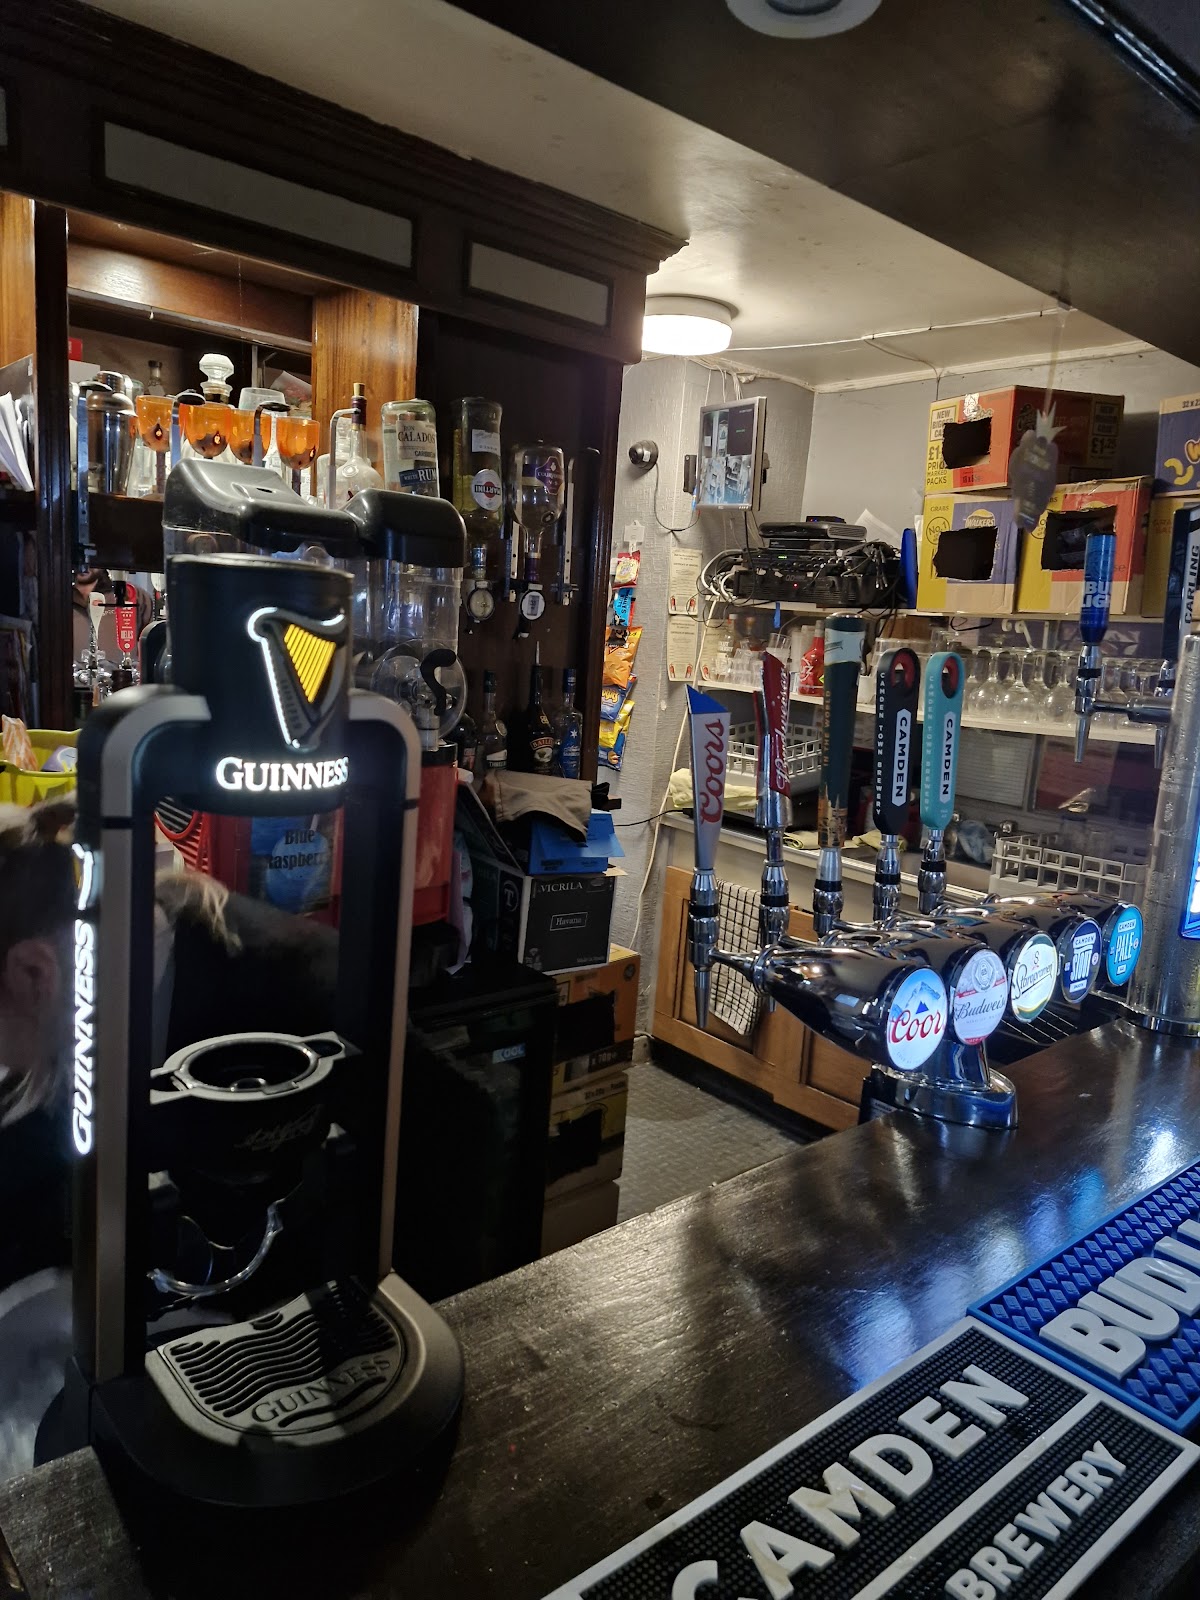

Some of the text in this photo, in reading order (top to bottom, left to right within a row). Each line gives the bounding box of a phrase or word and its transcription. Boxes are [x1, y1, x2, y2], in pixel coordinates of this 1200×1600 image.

[936, 410, 951, 419] NEW
[397, 431, 436, 444] CALADOS
[418, 467, 437, 482] RUM
[926, 476, 948, 486] PACKS
[965, 517, 995, 527] WALKERS
[1184, 545, 1200, 625] CARLING
[926, 675, 935, 720] CAMDEN
[895, 716, 908, 797] CAMDEN
[942, 718, 953, 795] CAMDEN
[215, 756, 349, 792] GUINNESS
[700, 718, 724, 826] Coors
[285, 829, 315, 845] Blue
[540, 882, 583, 893] VICRILA
[556, 916, 582, 926] Havana
[1119, 921, 1135, 931] CAMDEN
[1075, 936, 1095, 946] CAMDEN
[1114, 932, 1135, 964] PALE
[72, 919, 95, 1155] GUINNESS
[251, 1355, 391, 1423] GUINNESS
[945, 1440, 1127, 1600] BREWERY
